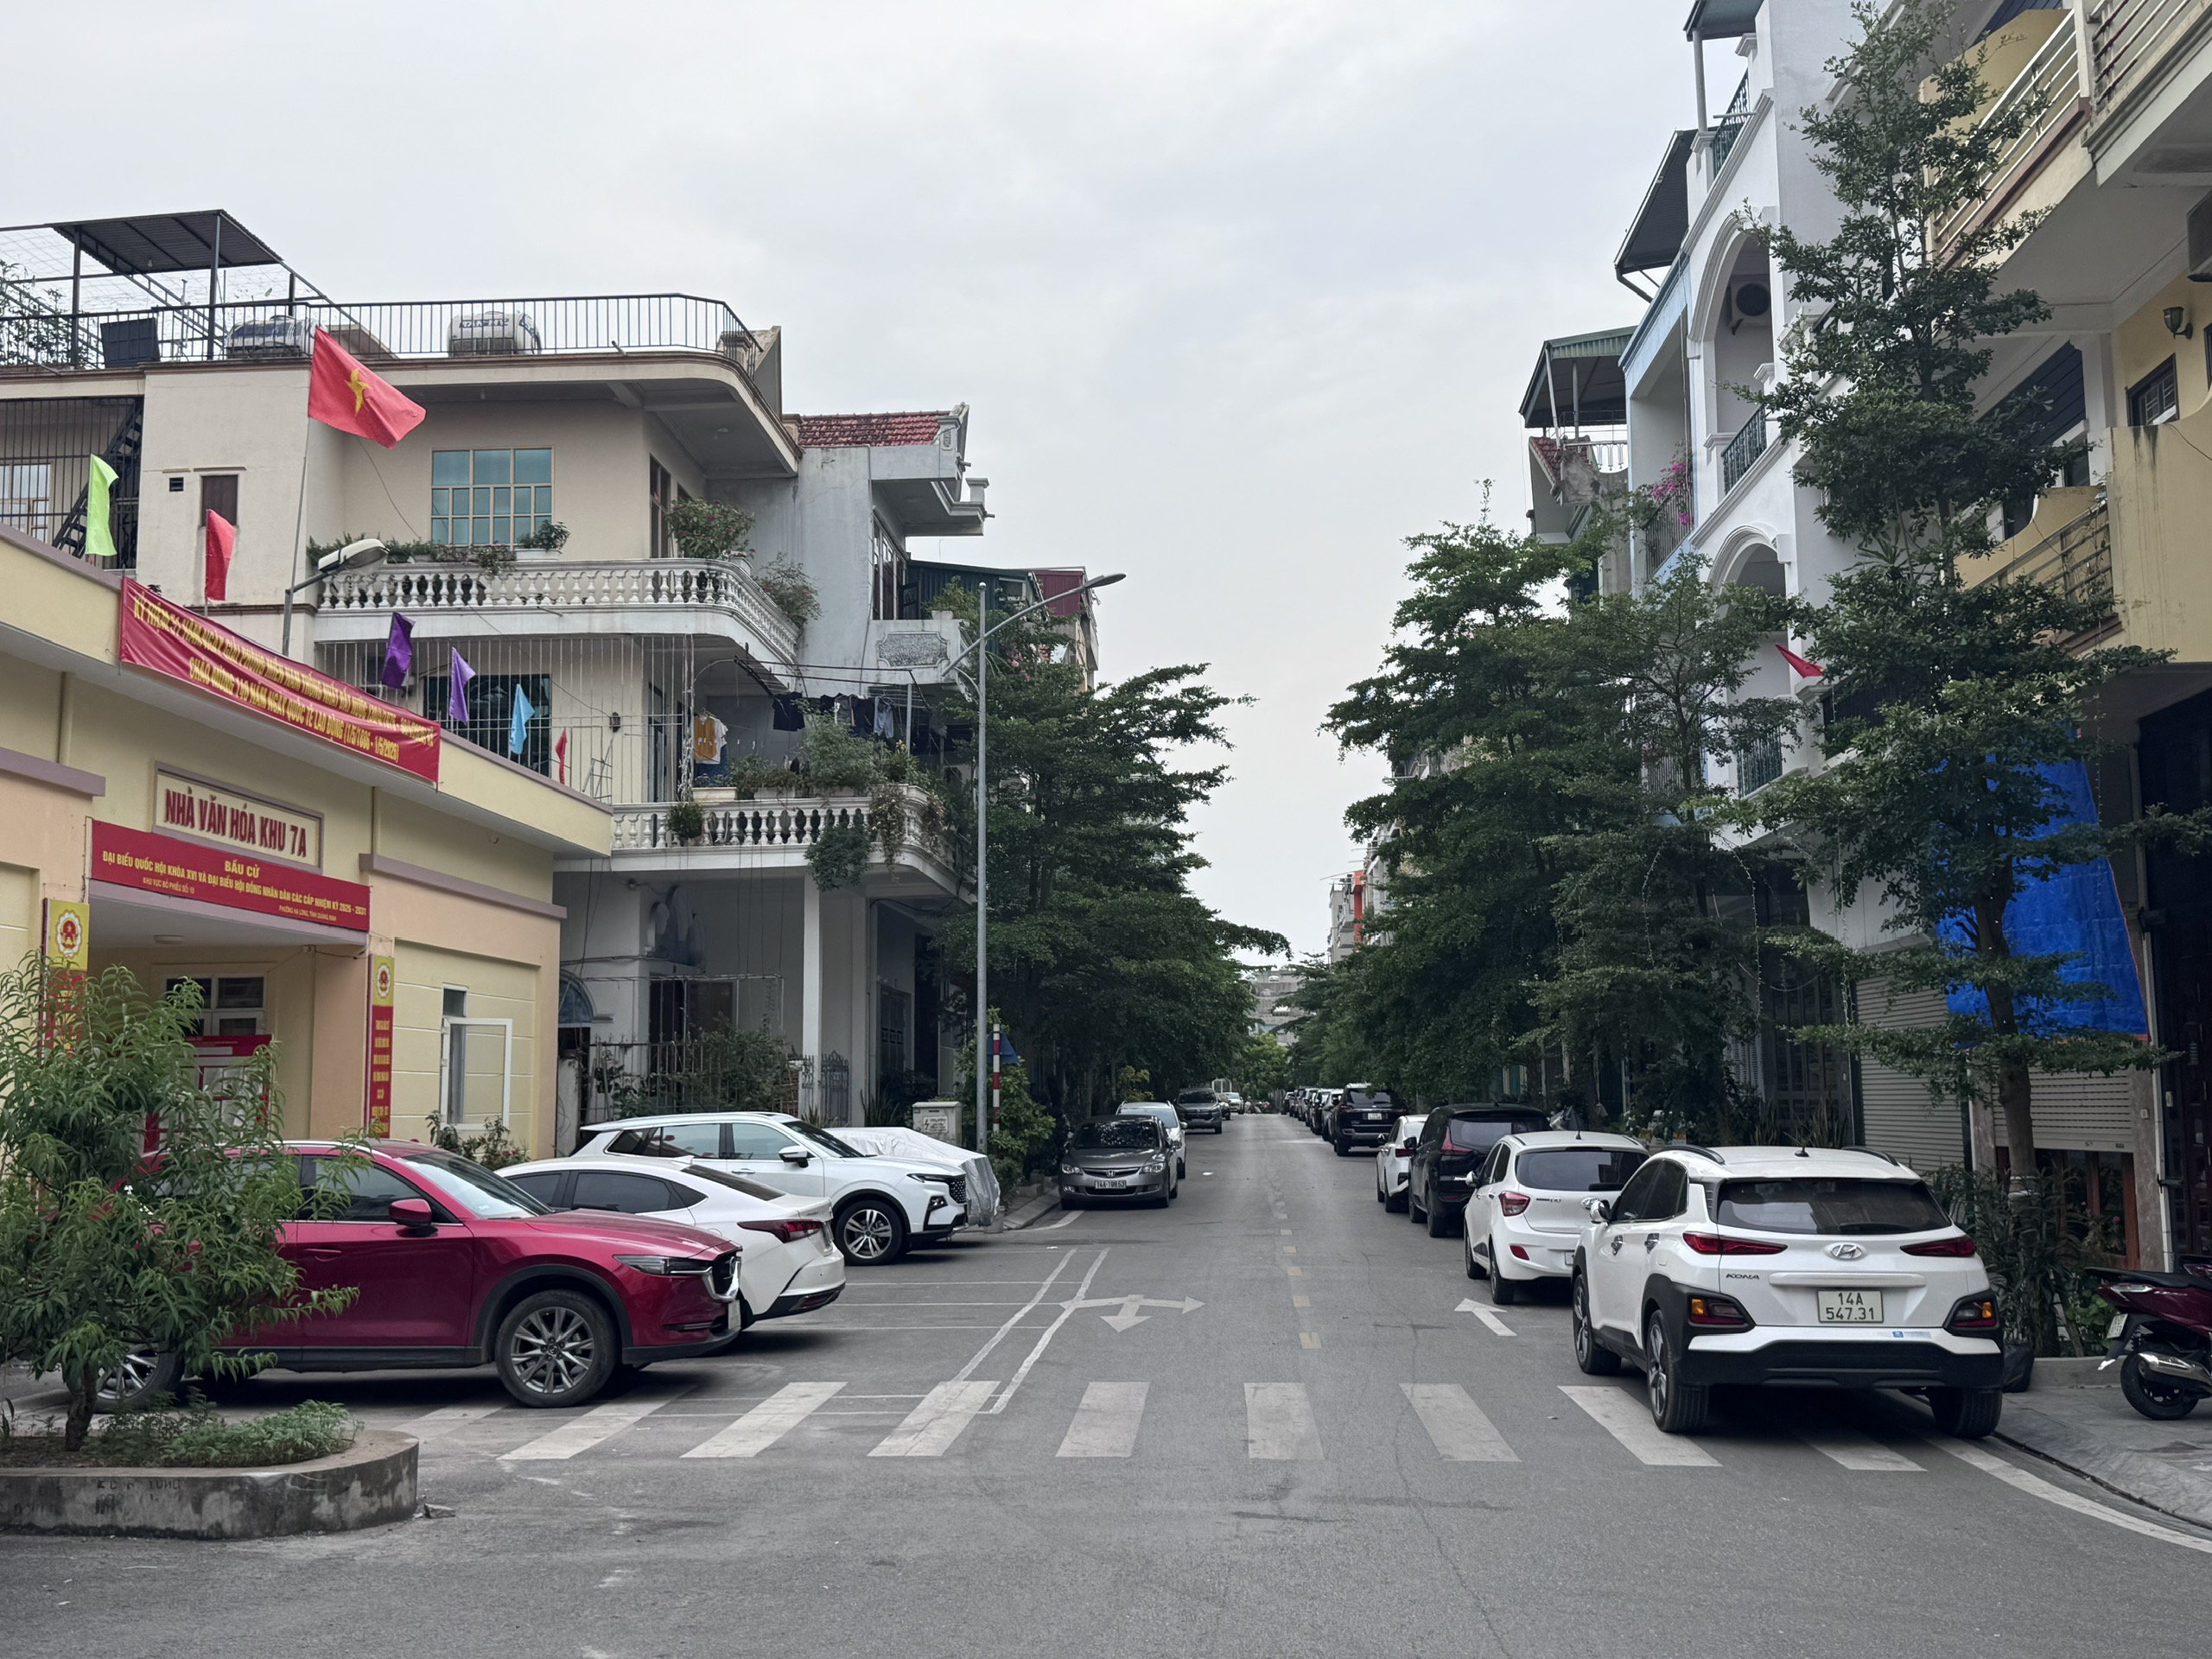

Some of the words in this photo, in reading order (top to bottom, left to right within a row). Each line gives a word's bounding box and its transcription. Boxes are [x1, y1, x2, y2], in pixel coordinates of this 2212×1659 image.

[165, 786, 195, 828] NHÀ
[198, 794, 228, 836] VĂN
[229, 804, 257, 846] HÓA
[258, 815, 287, 852] KHU
[289, 824, 308, 858] 7A
[102, 850, 116, 866] ĐẠI
[117, 851, 133, 867] BIỂU
[134, 856, 154, 872] QUỐC
[154, 861, 167, 875] HỘI
[168, 865, 185, 879] KHÓA
[186, 868, 198, 881] XVI
[198, 871, 207, 883] VÀ
[207, 873, 219, 887] ĐẠI
[219, 874, 234, 888] BIỂU
[224, 858, 245, 875] BẦU
[245, 864, 260, 879] CỬ
[1838, 1292, 1863, 1306] 14A
[1826, 1306, 1874, 1320] 547.31
